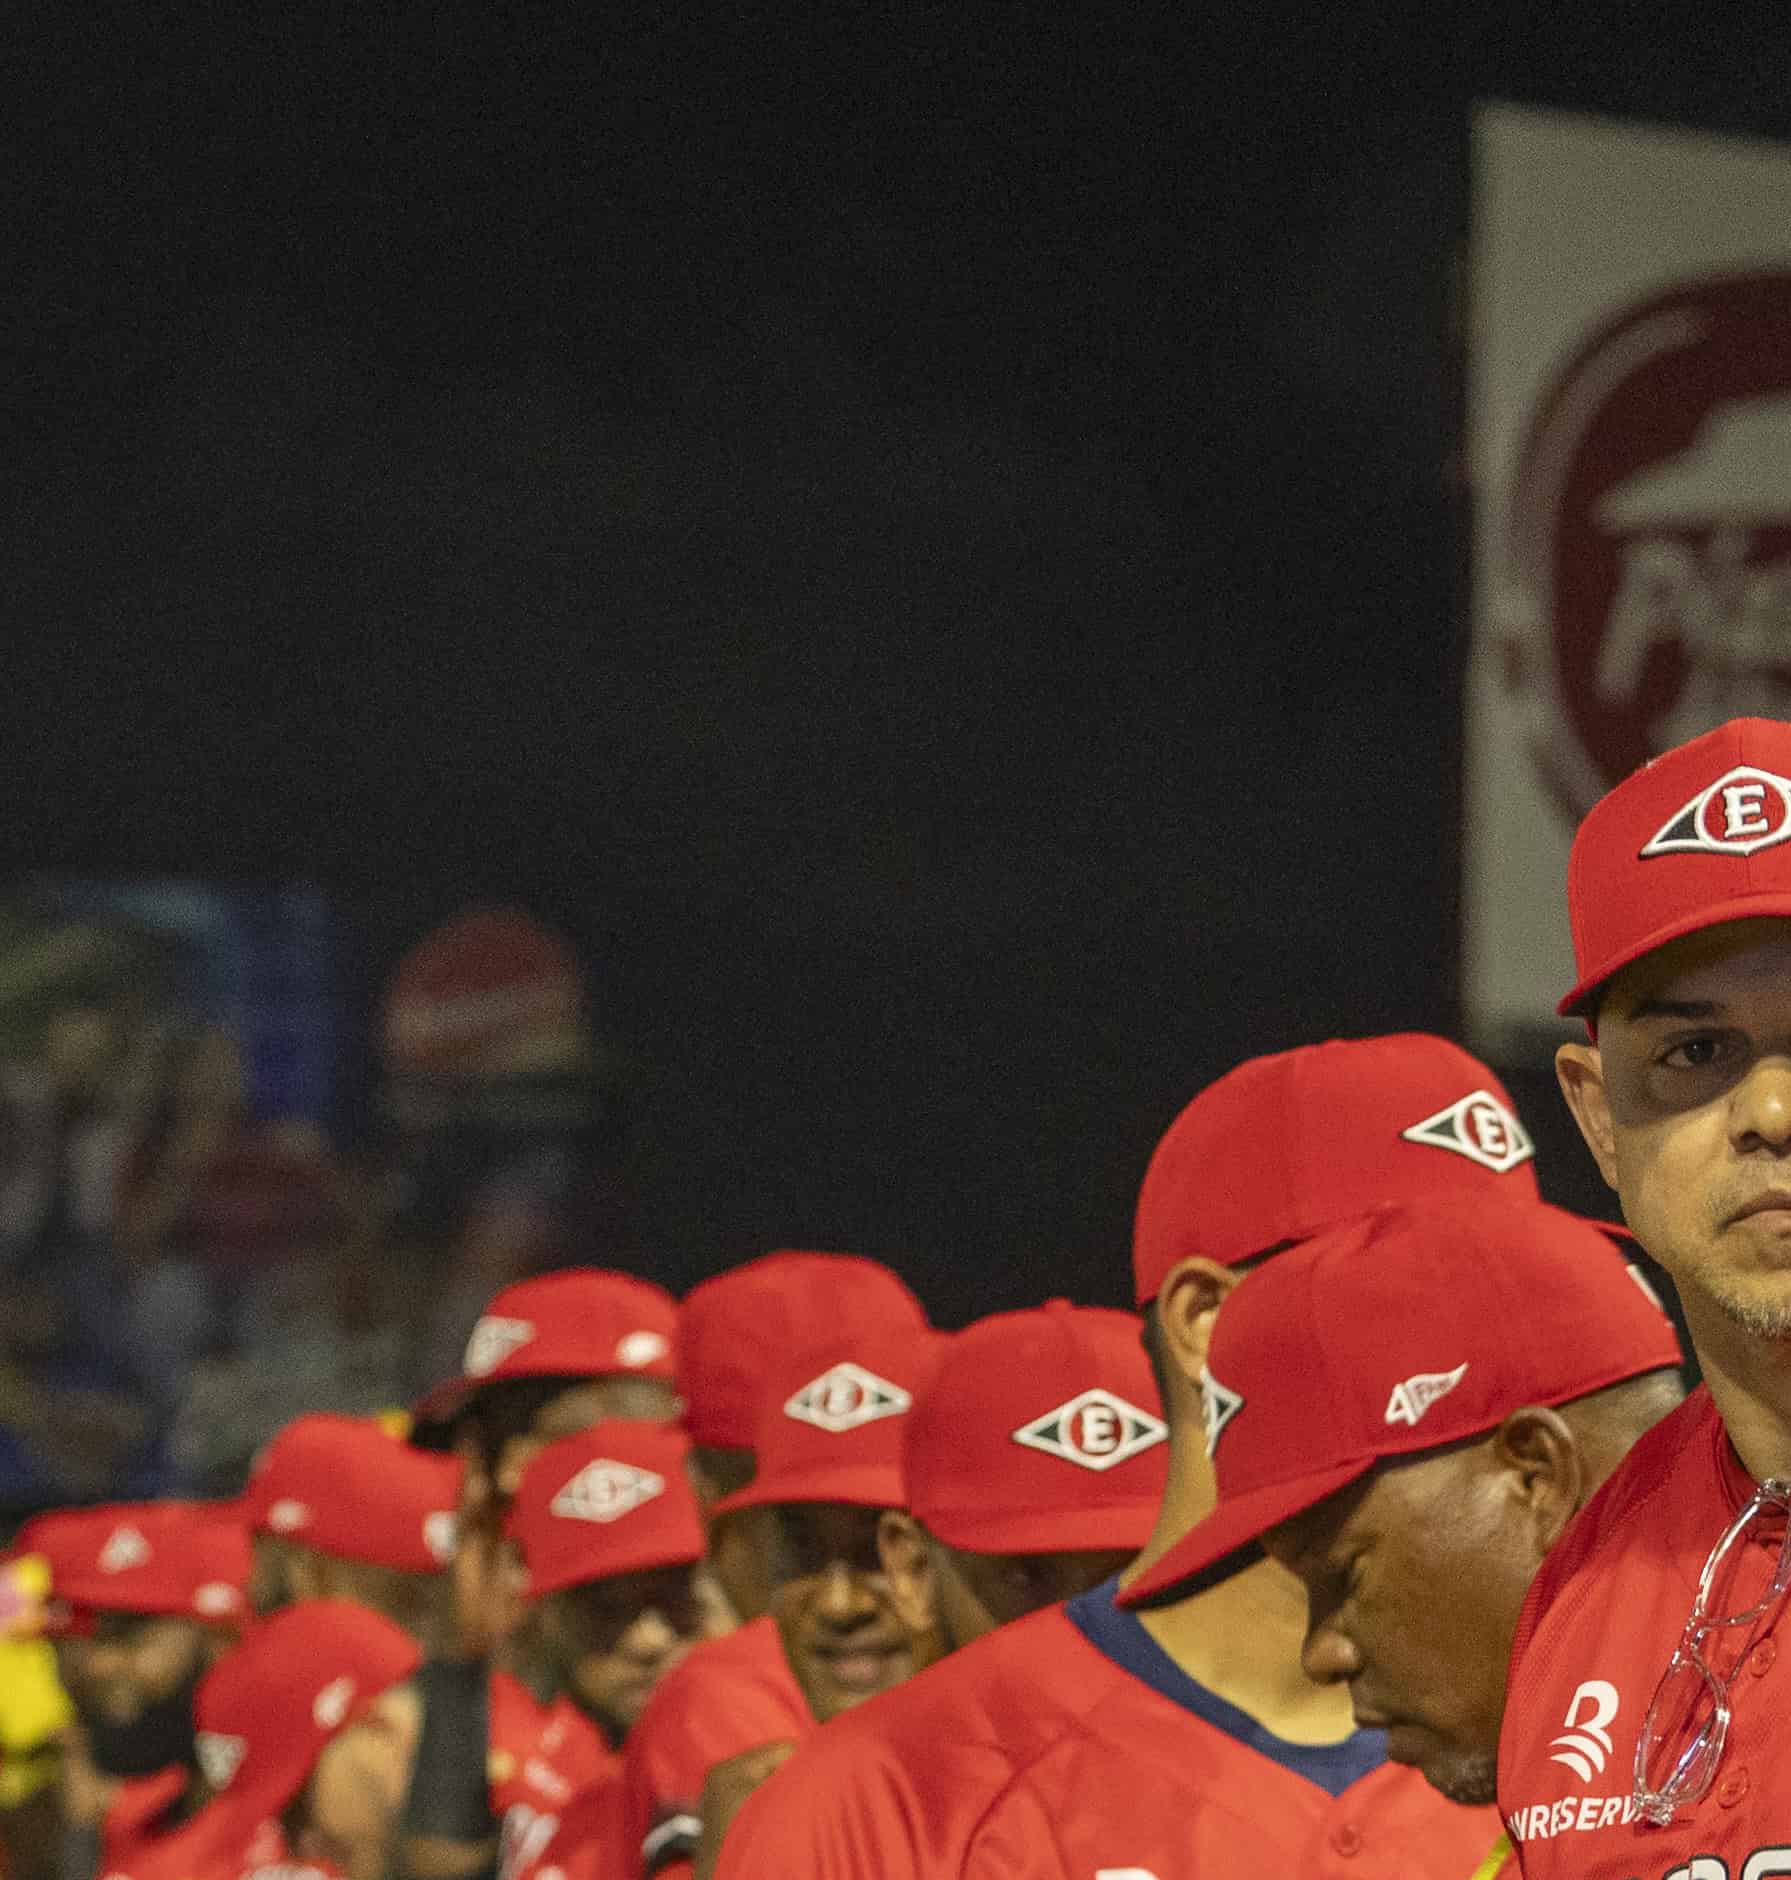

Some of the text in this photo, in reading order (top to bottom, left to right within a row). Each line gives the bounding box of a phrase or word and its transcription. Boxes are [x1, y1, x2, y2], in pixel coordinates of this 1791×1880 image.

[1721, 783, 1769, 837] E
[1473, 1103, 1507, 1155] E
[1080, 1405, 1121, 1453] E
